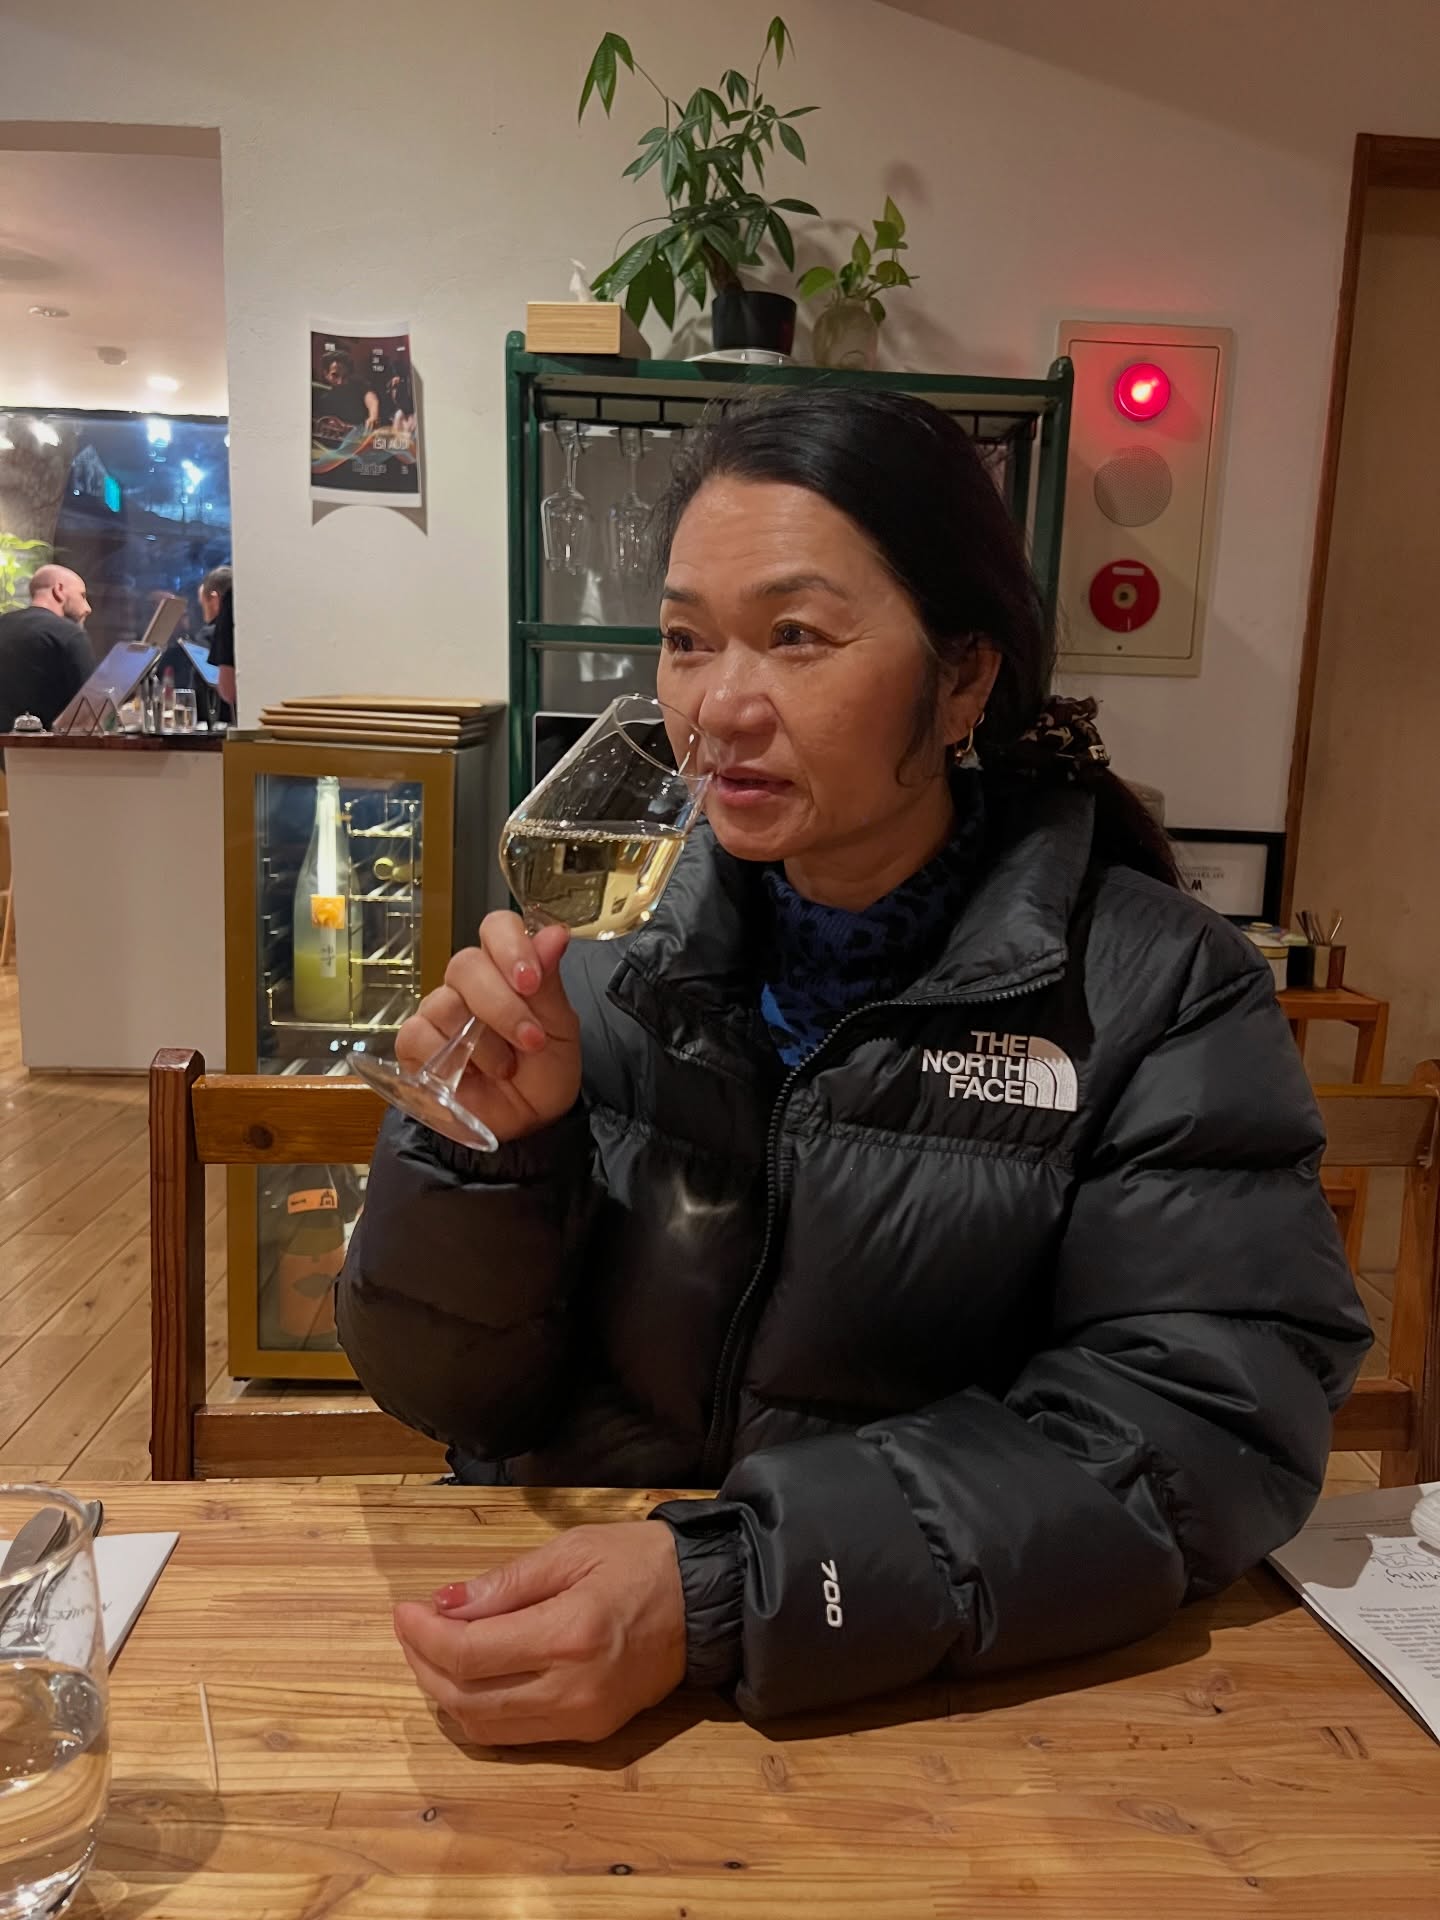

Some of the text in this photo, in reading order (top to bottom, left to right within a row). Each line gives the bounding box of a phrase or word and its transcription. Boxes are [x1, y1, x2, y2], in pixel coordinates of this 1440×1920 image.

[970, 1030, 1029, 1057] THE
[921, 1048, 1026, 1081] NORTH
[948, 1074, 1024, 1104] FACE
[821, 1560, 843, 1627] 700
